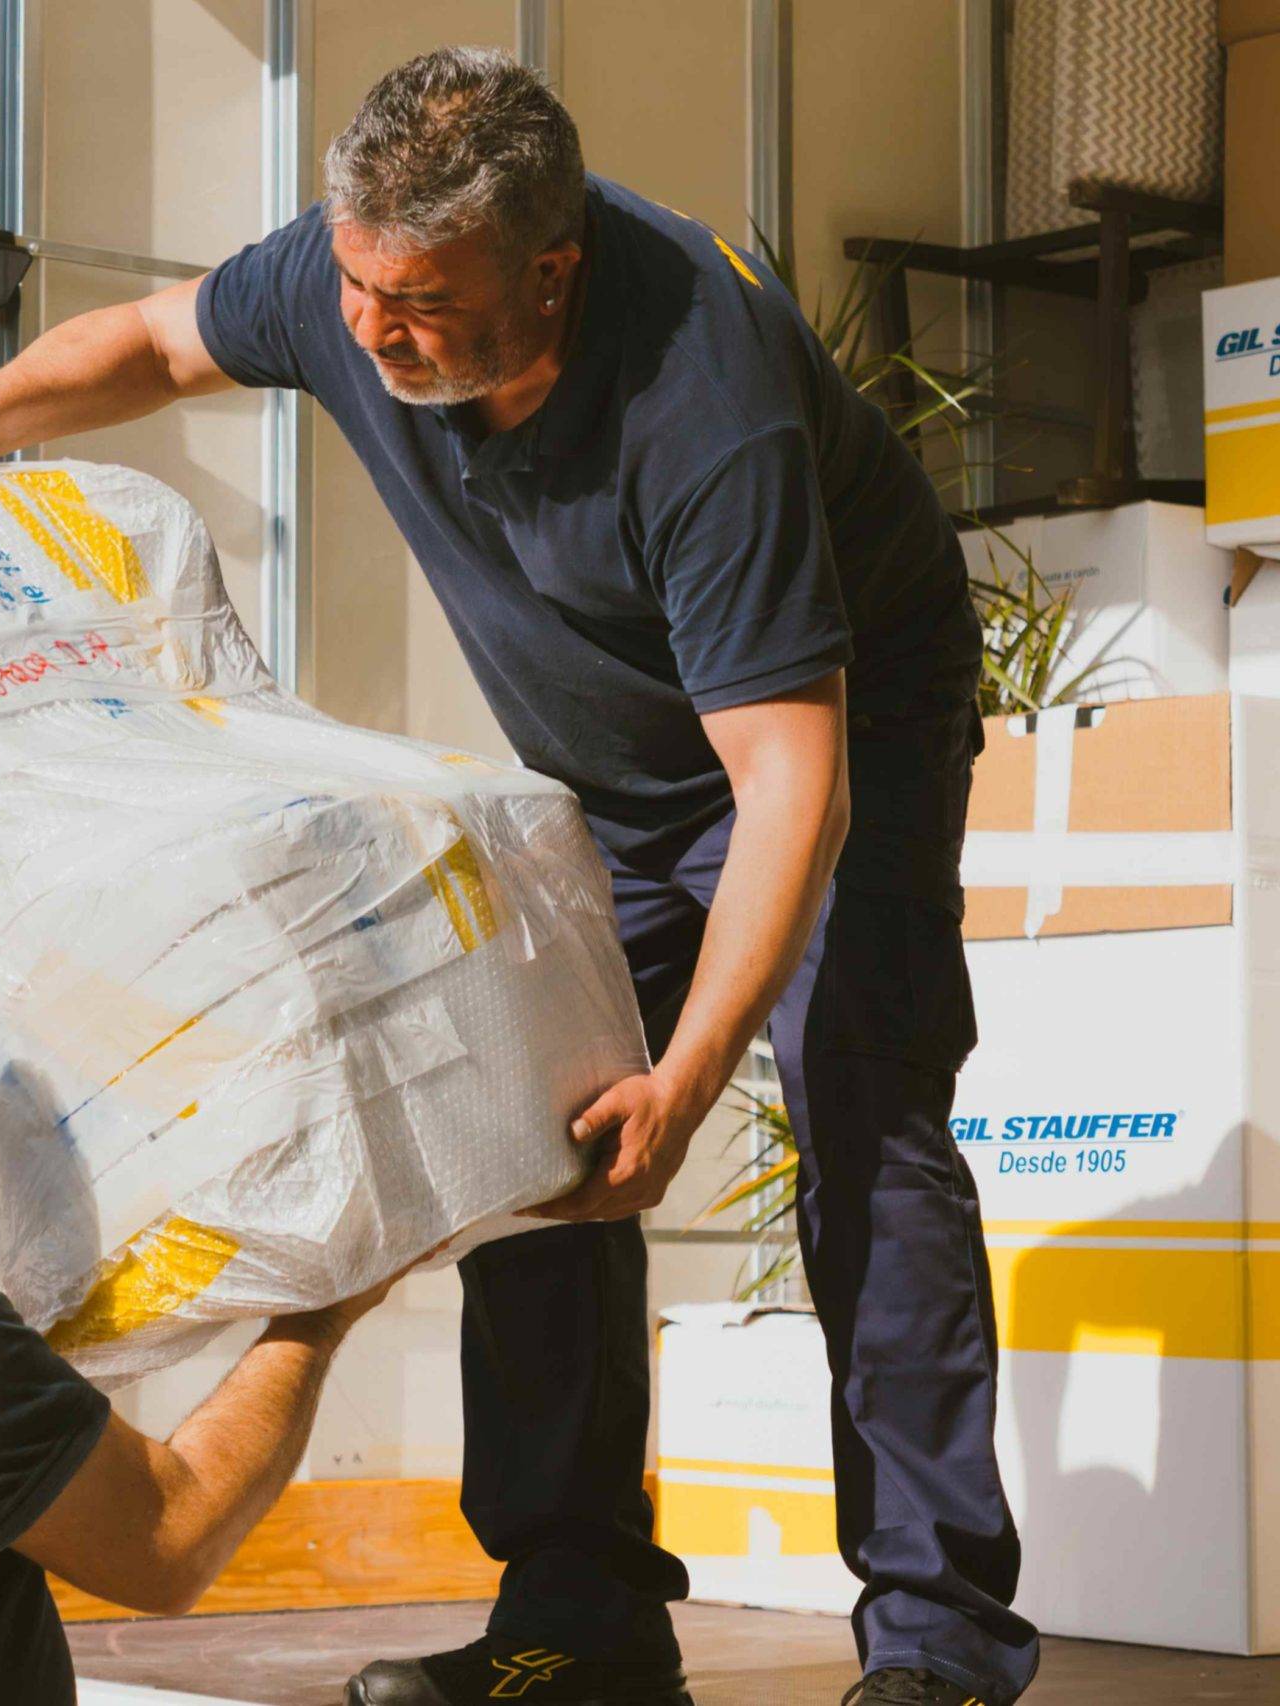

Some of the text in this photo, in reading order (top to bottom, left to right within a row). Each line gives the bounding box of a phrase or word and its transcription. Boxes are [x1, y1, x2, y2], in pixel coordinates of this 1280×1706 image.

[1216, 327, 1264, 357] GIL
[948, 1112, 1178, 1141] GIL STAUFFER
[999, 1149, 1127, 1174] Desde 1905
